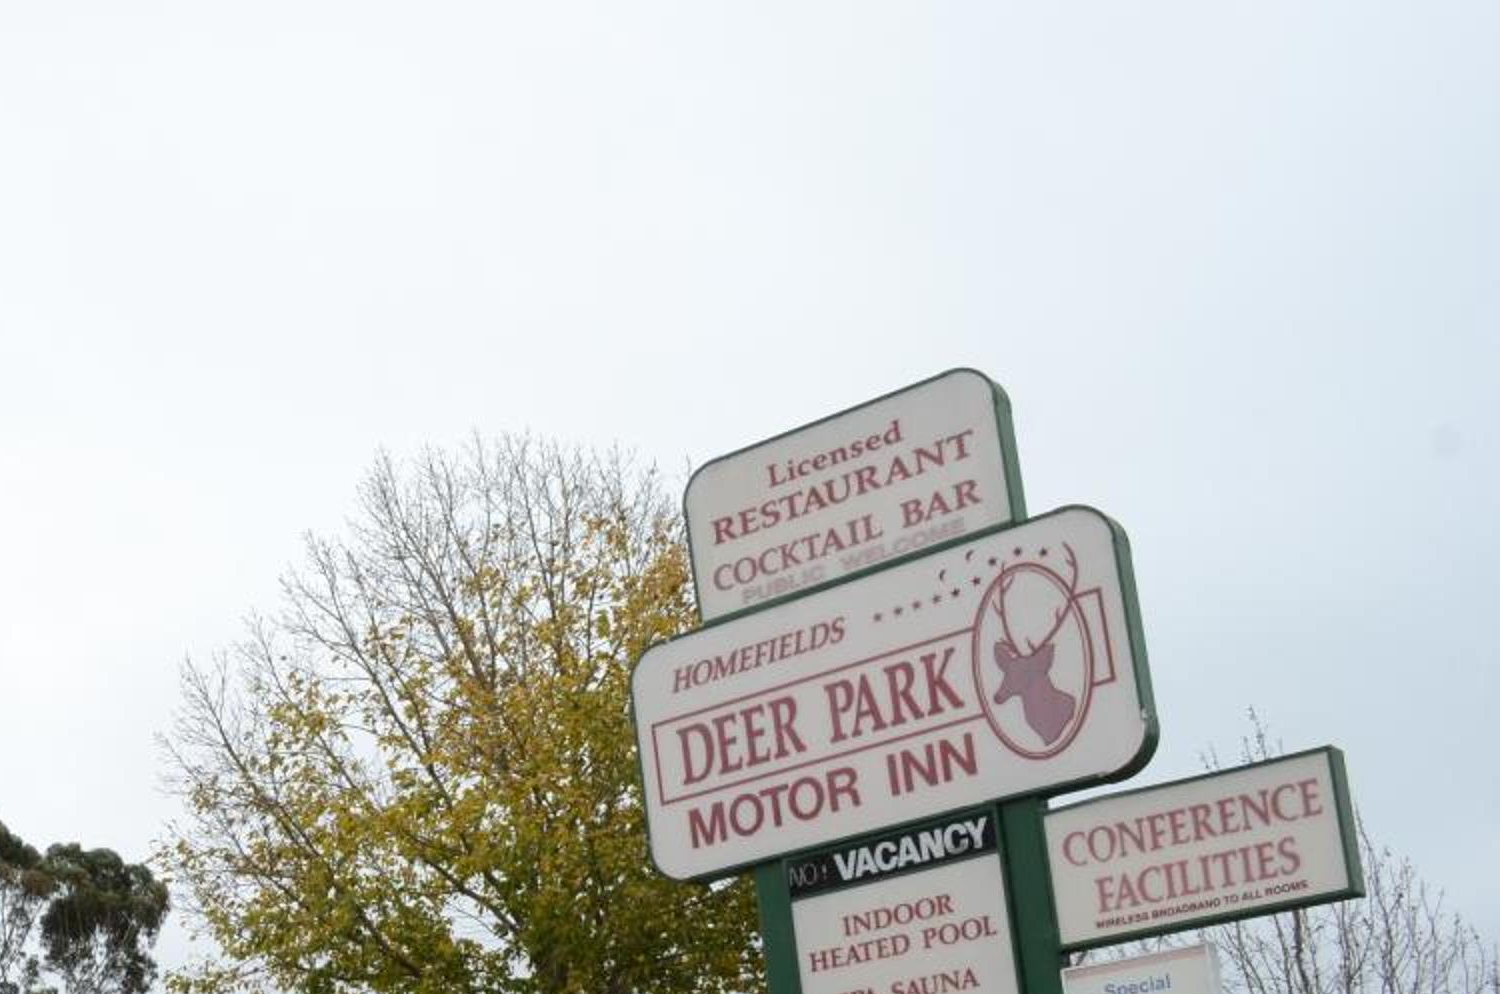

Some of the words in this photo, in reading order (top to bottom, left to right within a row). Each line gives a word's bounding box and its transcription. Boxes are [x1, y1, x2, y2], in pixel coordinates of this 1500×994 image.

[711, 429, 974, 545] RESTAURANT
[767, 419, 904, 488] Licensed
[713, 514, 884, 591] COCKTAIL
[901, 479, 983, 529] BAR
[741, 564, 827, 604] PUBLIC
[841, 517, 966, 570] WELCOME
[673, 617, 846, 693] HOMEFIELDS
[677, 696, 807, 786] DEER
[824, 648, 965, 744] PARK
[688, 767, 862, 849] MOTOR
[887, 732, 978, 797] INN
[1062, 778, 1324, 866] CONFERENCE
[834, 817, 987, 881] VACANCY
[1094, 836, 1301, 913] FACILITIES
[843, 894, 954, 937] INDOOR
[1096, 910, 1148, 929] WIRELESS
[1152, 897, 1221, 919] BROADBAND
[1224, 894, 1239, 906] TO
[1242, 889, 1262, 902] ALL
[1265, 880, 1308, 897] ROOMS
[809, 934, 910, 972] HEATED
[922, 915, 997, 949] POOL
